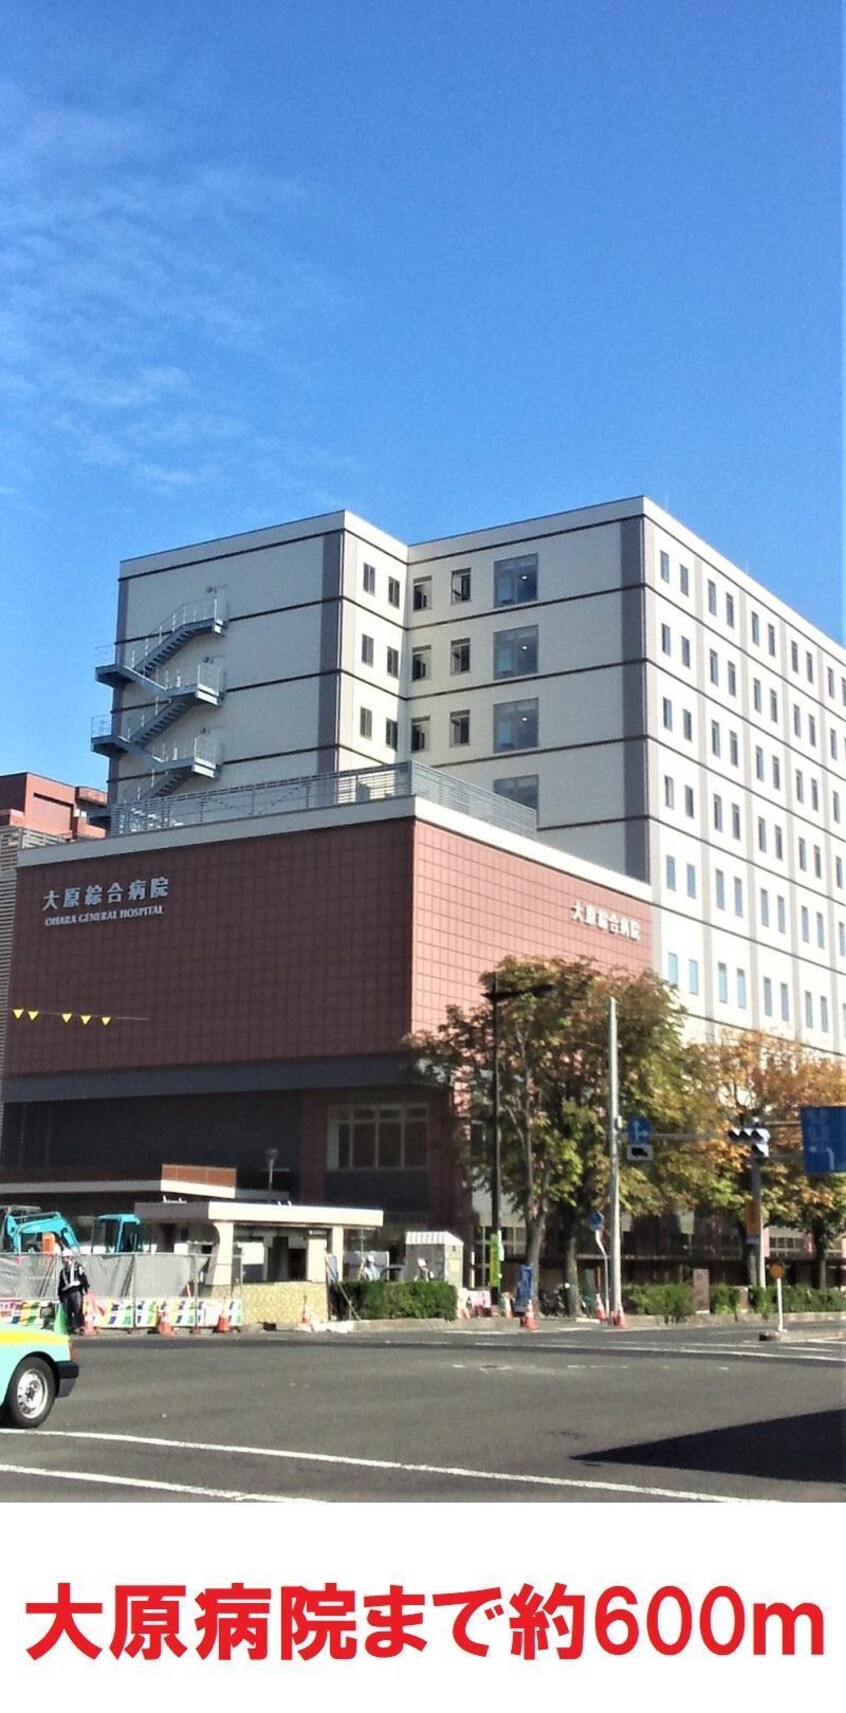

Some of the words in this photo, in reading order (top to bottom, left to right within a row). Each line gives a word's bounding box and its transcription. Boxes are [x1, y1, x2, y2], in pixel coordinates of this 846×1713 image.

[43, 877, 169, 910] 大原綜合病院
[45, 913, 77, 926] OHARA
[78, 910, 117, 923] GENERAL
[119, 906, 164, 919] HOSPITAL
